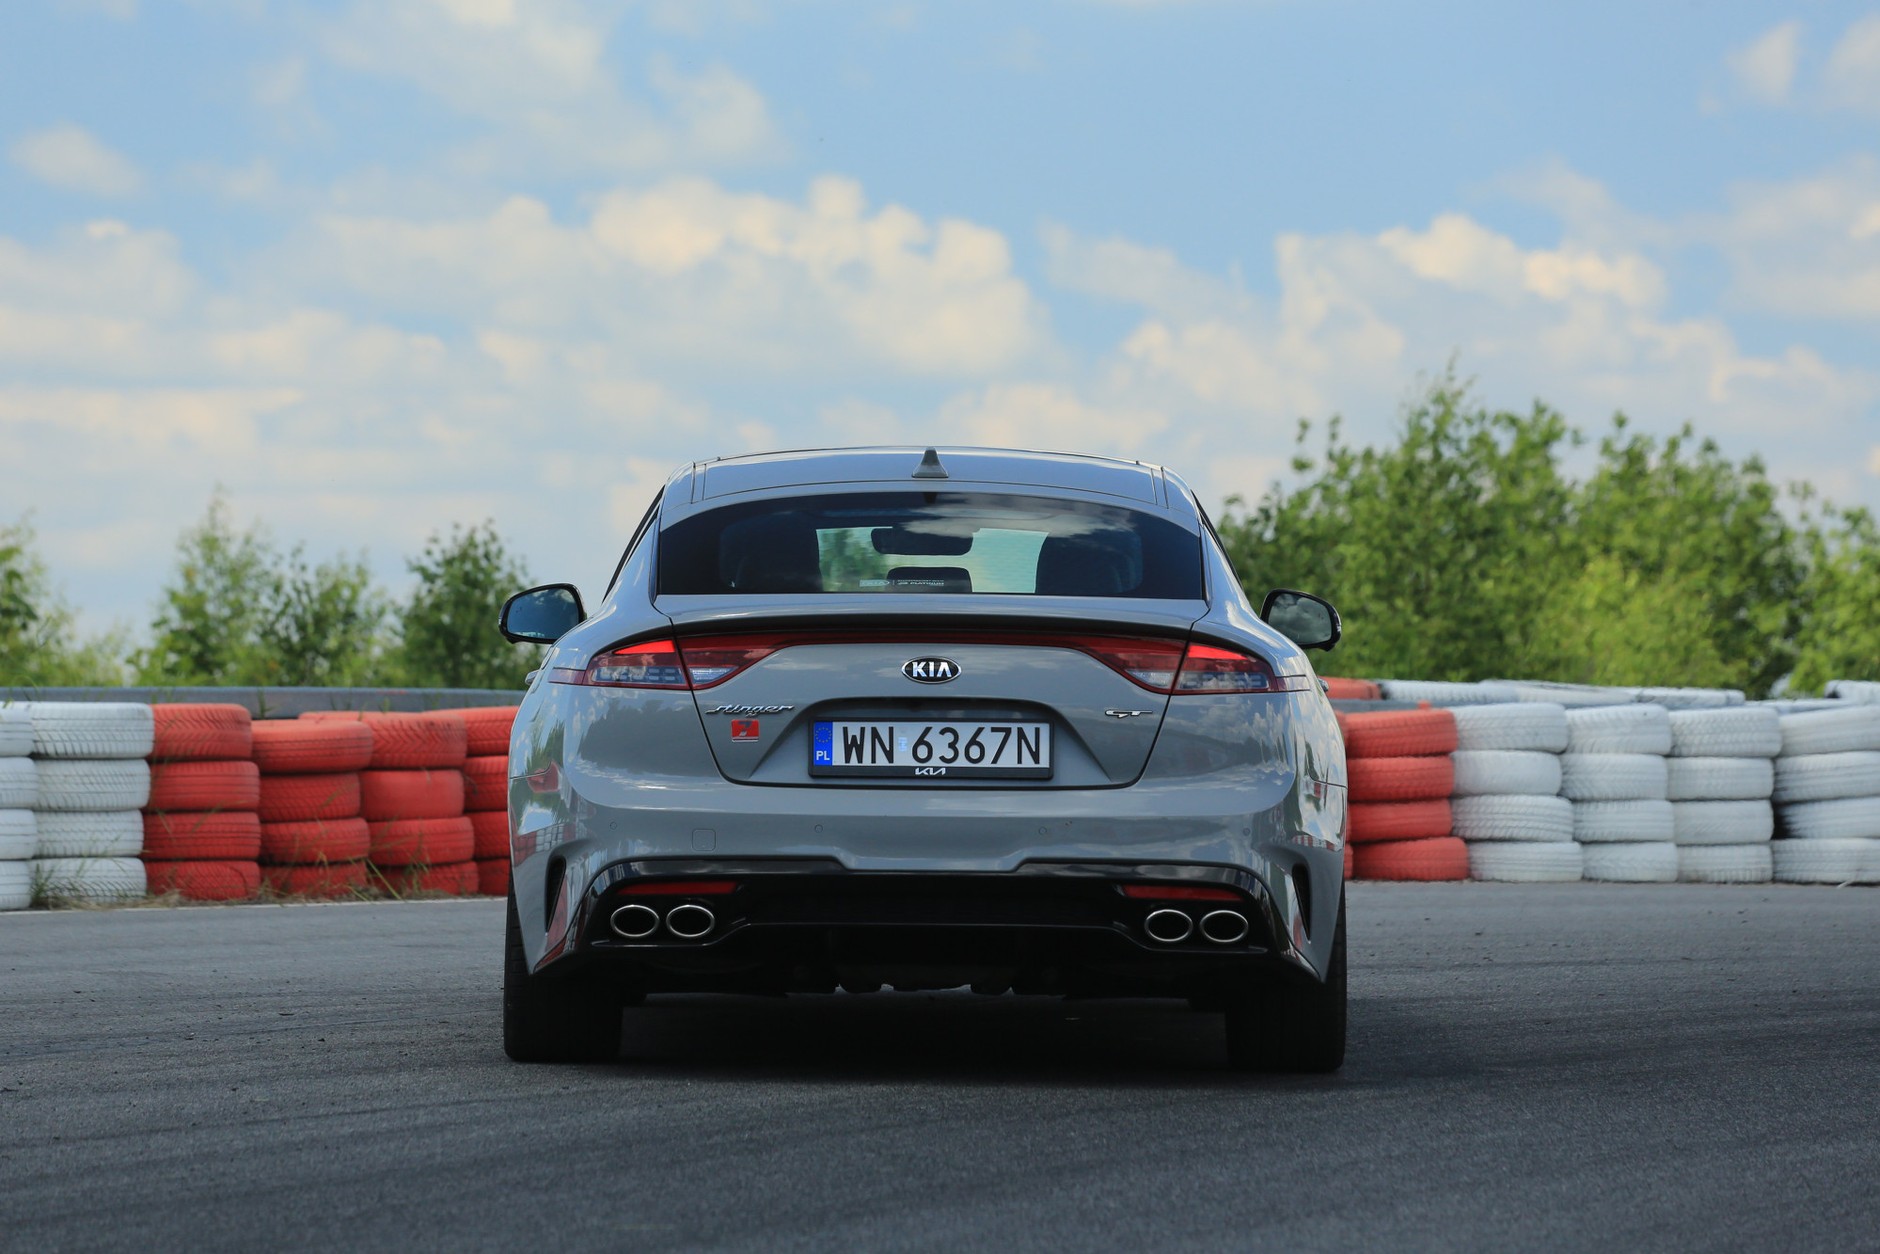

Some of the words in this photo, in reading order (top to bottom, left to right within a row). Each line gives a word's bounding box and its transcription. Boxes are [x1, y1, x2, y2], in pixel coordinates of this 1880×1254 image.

[912, 661, 952, 678] KIA
[1105, 710, 1153, 719] GT
[842, 726, 894, 764] WN
[911, 726, 1040, 764] 6367N
[816, 750, 831, 761] PL
[915, 767, 947, 776] KIA
